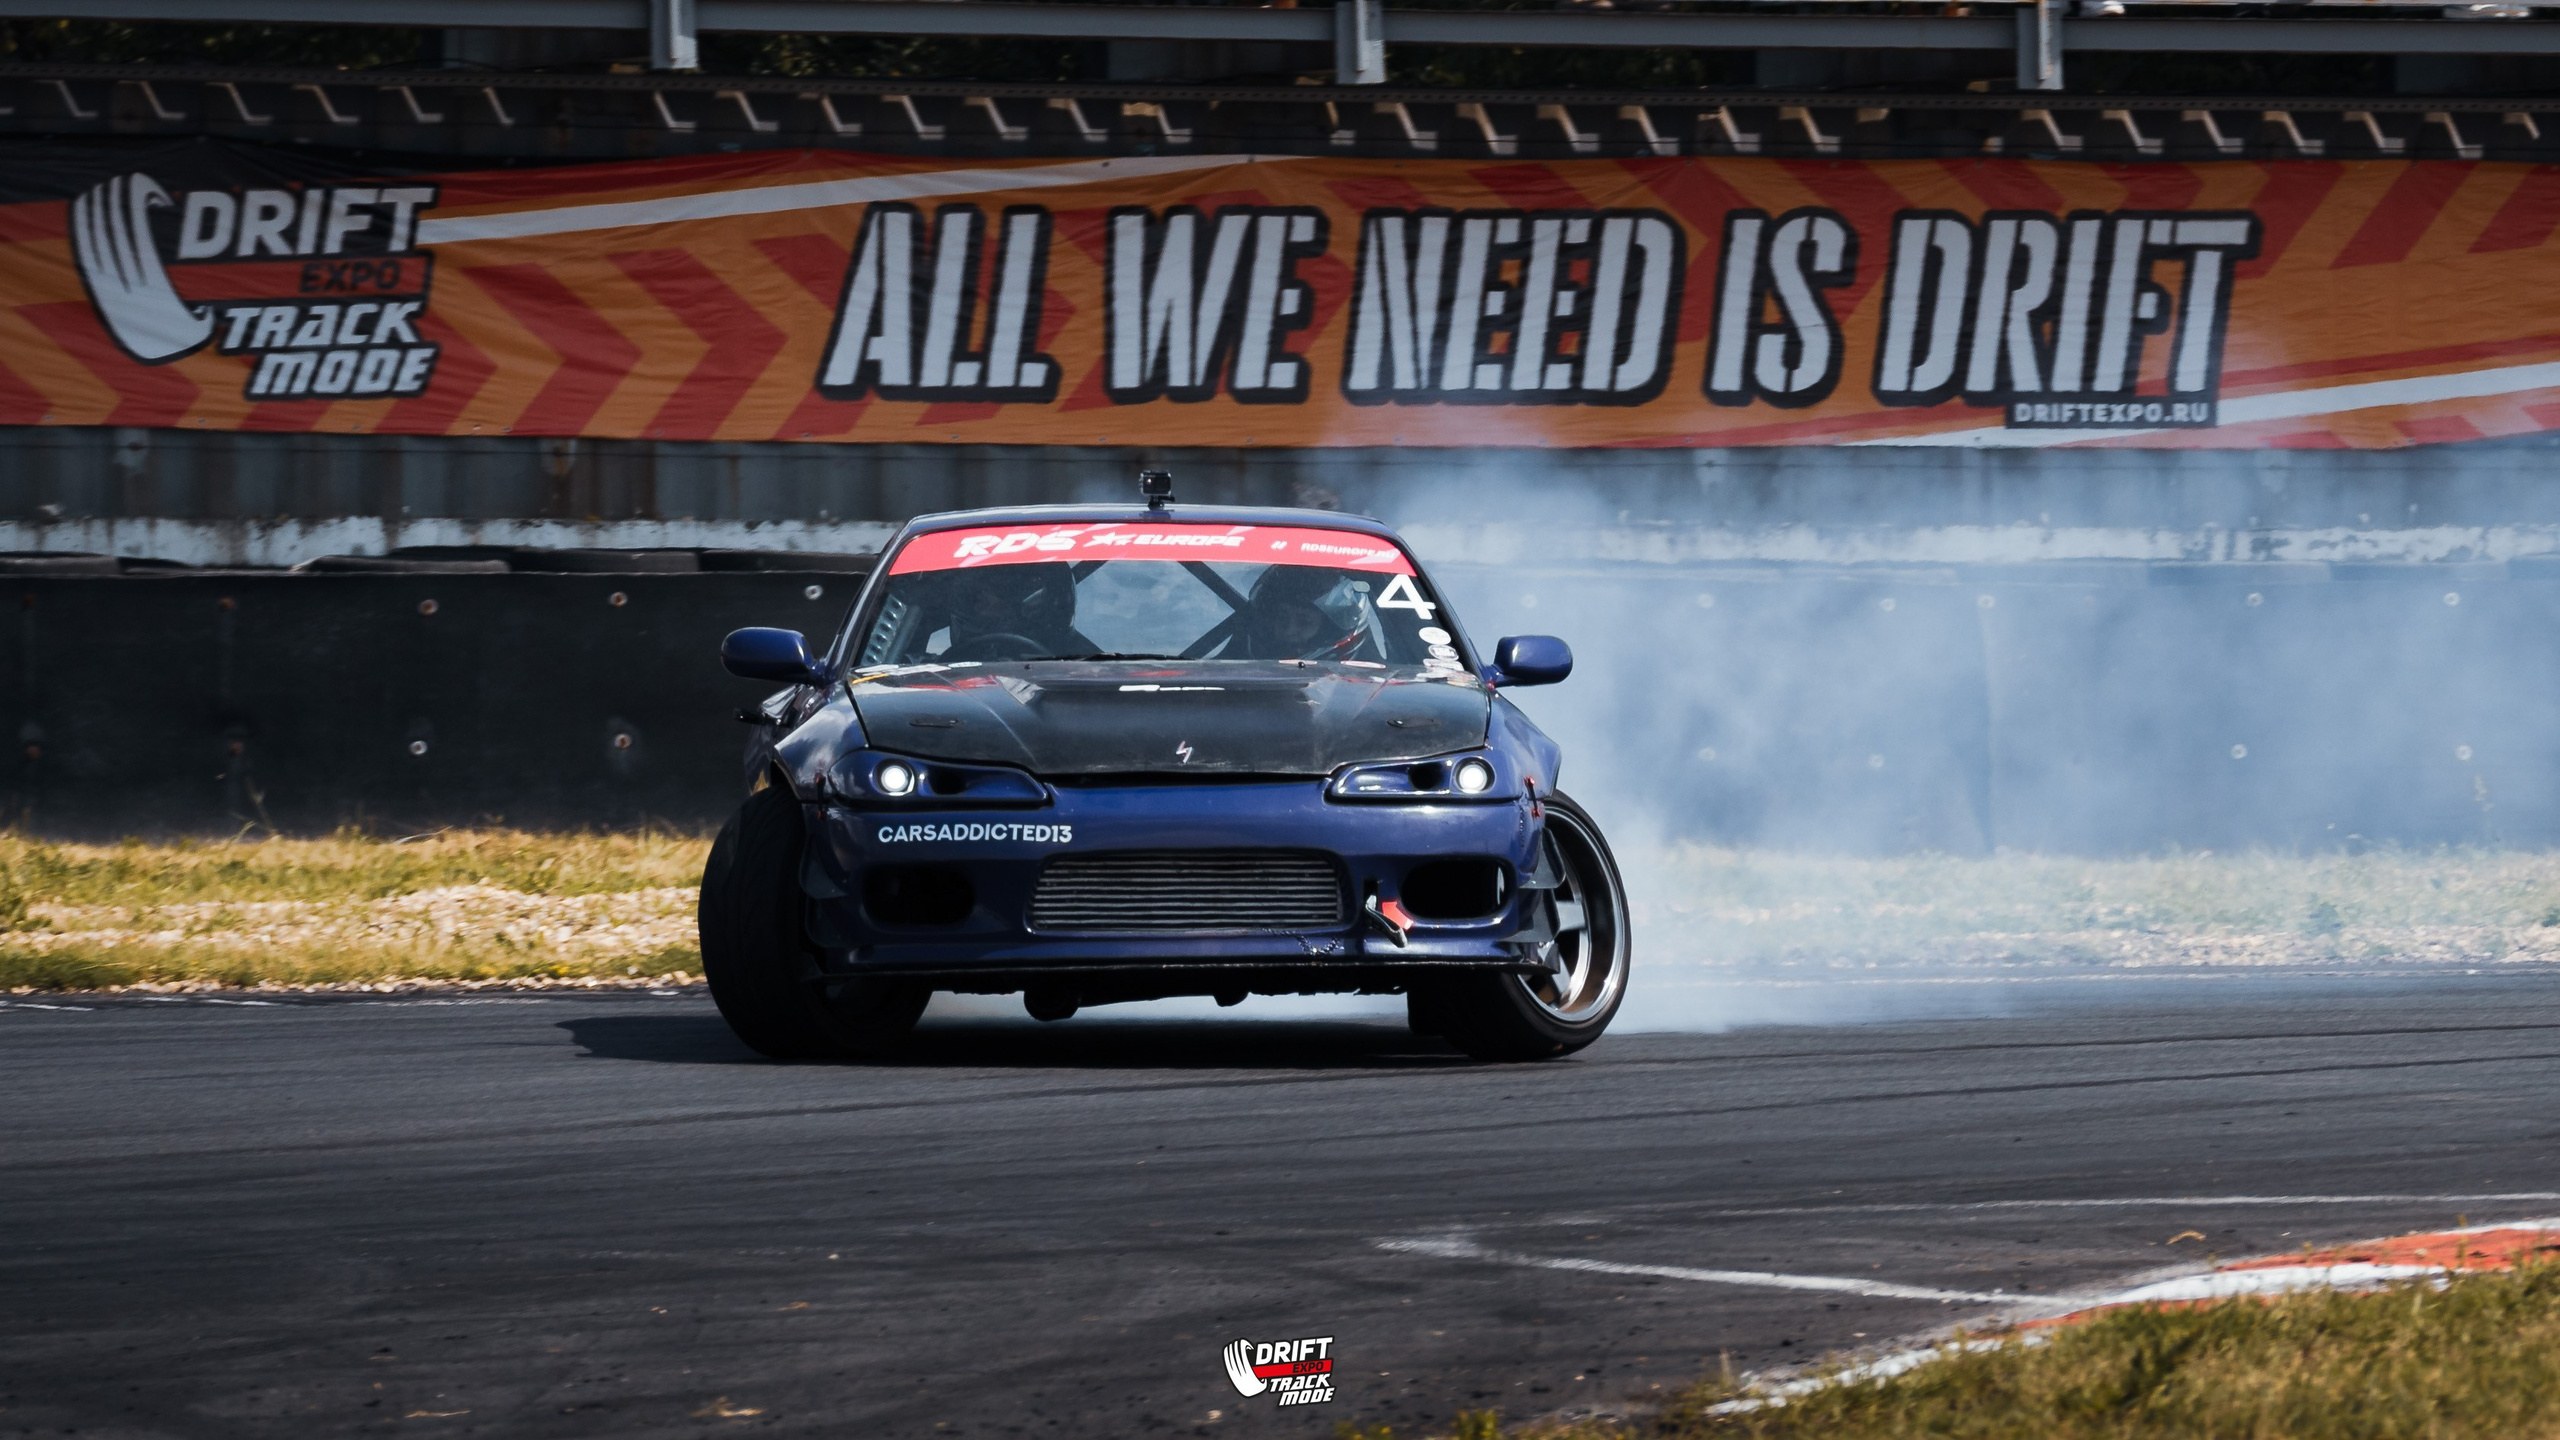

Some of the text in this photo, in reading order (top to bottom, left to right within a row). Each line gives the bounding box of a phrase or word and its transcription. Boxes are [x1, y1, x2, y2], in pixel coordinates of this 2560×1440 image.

[179, 187, 436, 259] DRIFT
[300, 260, 400, 293] EXPO
[823, 210, 2251, 393] ALL WE NEED IS DRIFT
[220, 302, 422, 350] TRACK
[248, 346, 437, 395] MODE
[2013, 402, 2209, 423] DRIFTEXPO.RU
[953, 530, 1246, 558] RDS EUROPE
[1376, 573, 1437, 620] 4
[878, 824, 1073, 844] CARSADDICTED13
